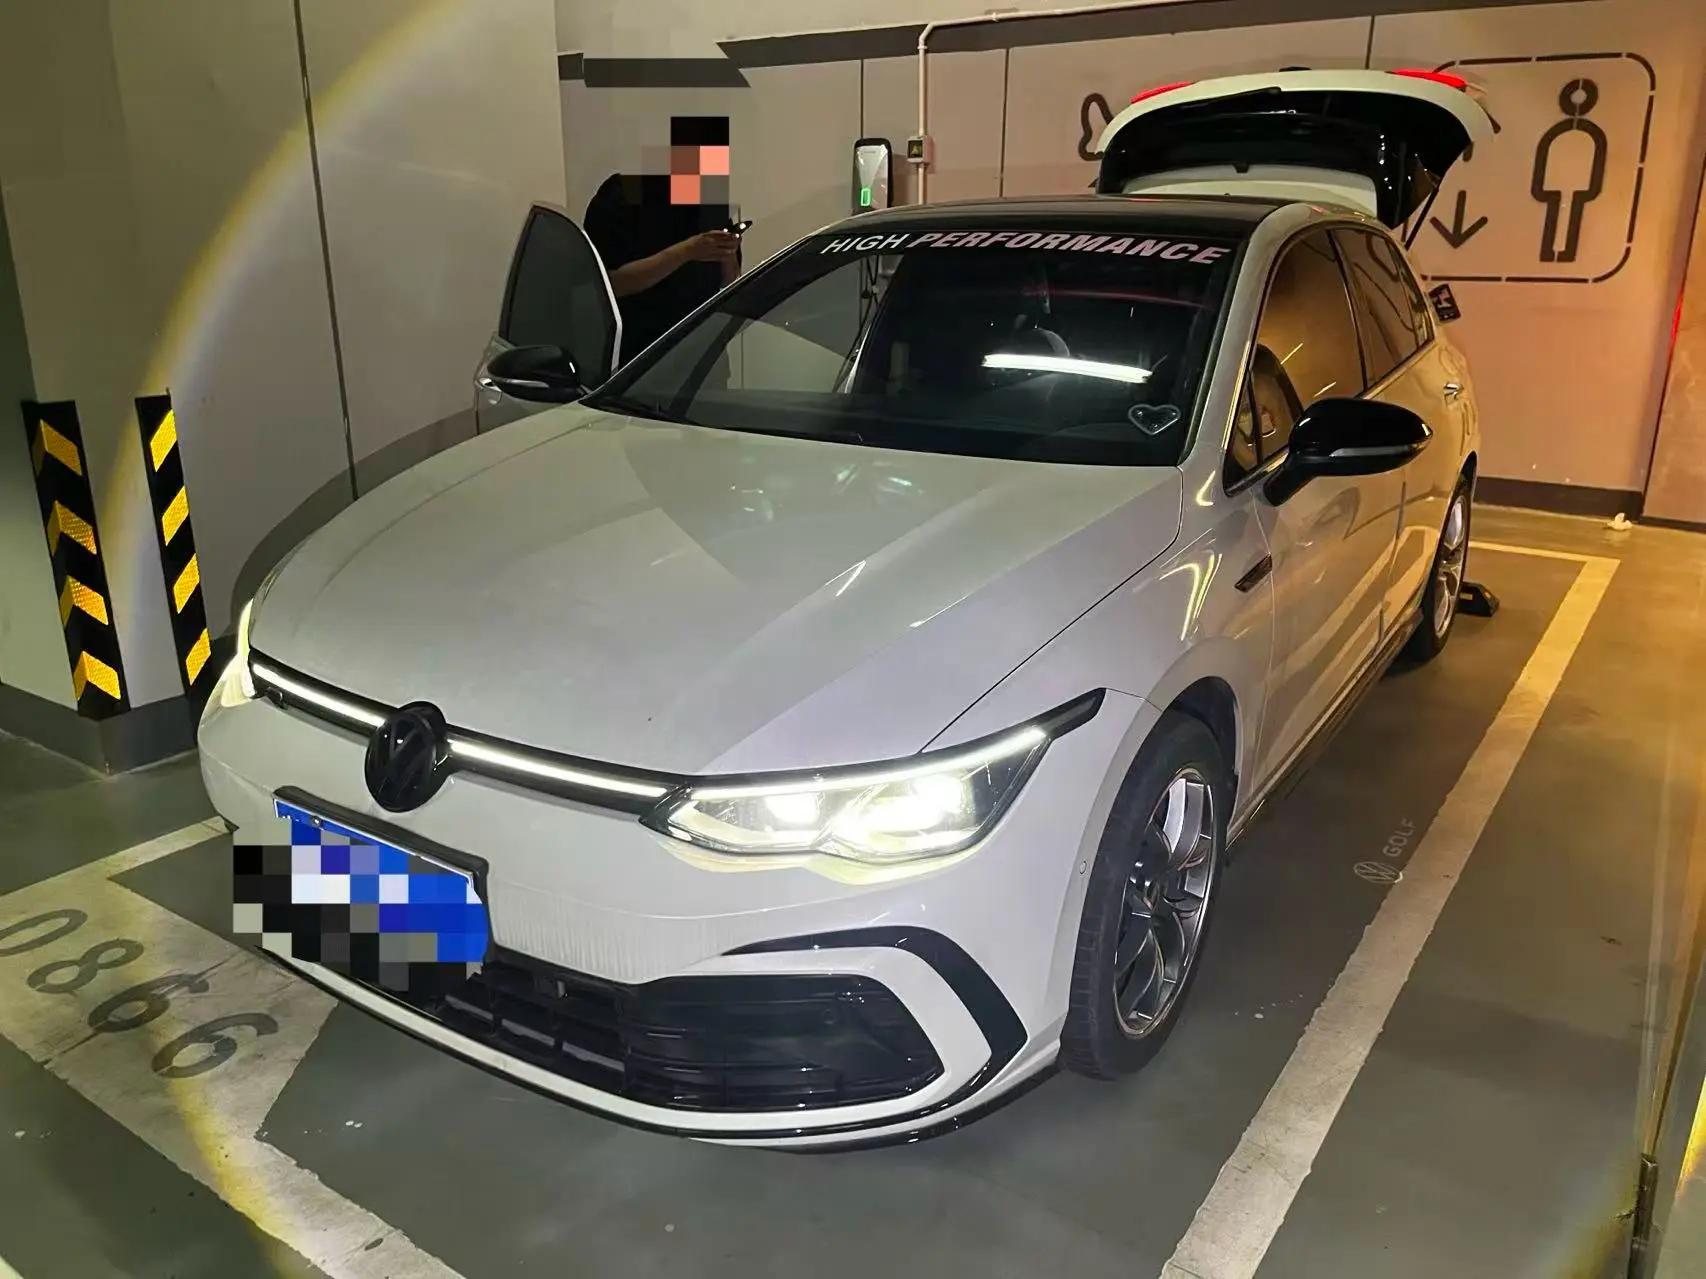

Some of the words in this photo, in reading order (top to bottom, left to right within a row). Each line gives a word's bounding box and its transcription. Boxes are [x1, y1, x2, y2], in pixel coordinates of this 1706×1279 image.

[820, 233, 910, 254] HIGH
[905, 232, 1231, 264] PERFORMANCE
[1382, 818, 1416, 857] GOLF
